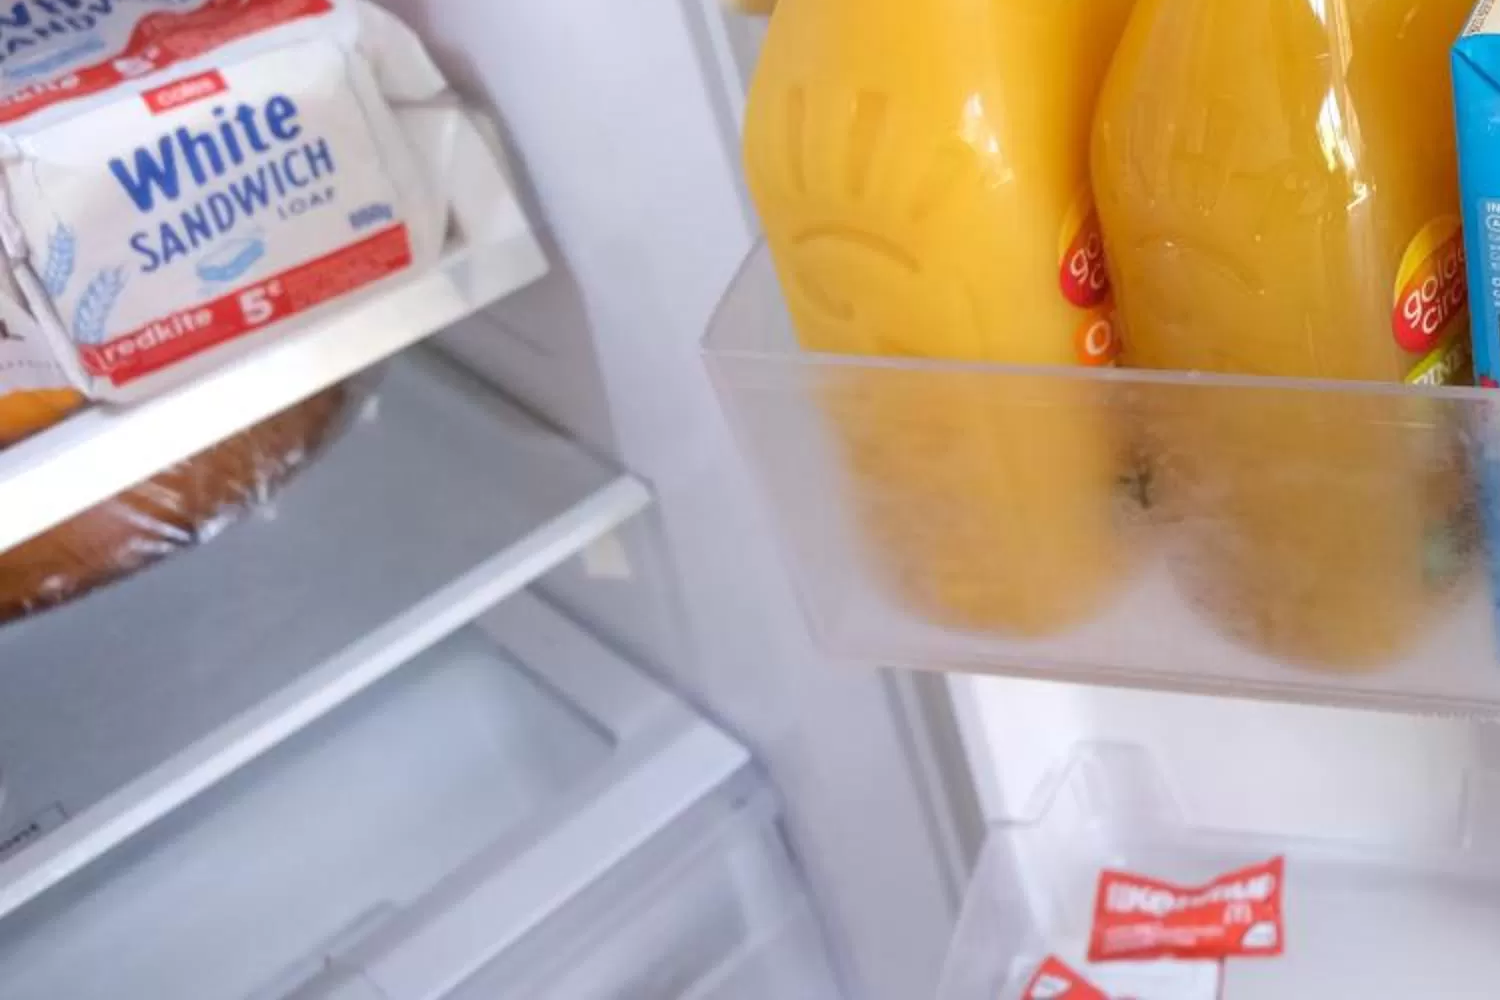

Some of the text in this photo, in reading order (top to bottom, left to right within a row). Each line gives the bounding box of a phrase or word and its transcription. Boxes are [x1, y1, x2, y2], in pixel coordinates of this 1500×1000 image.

[108, 94, 303, 213] White
[130, 136, 335, 273] SANDWICH
[101, 307, 213, 366] redkite
